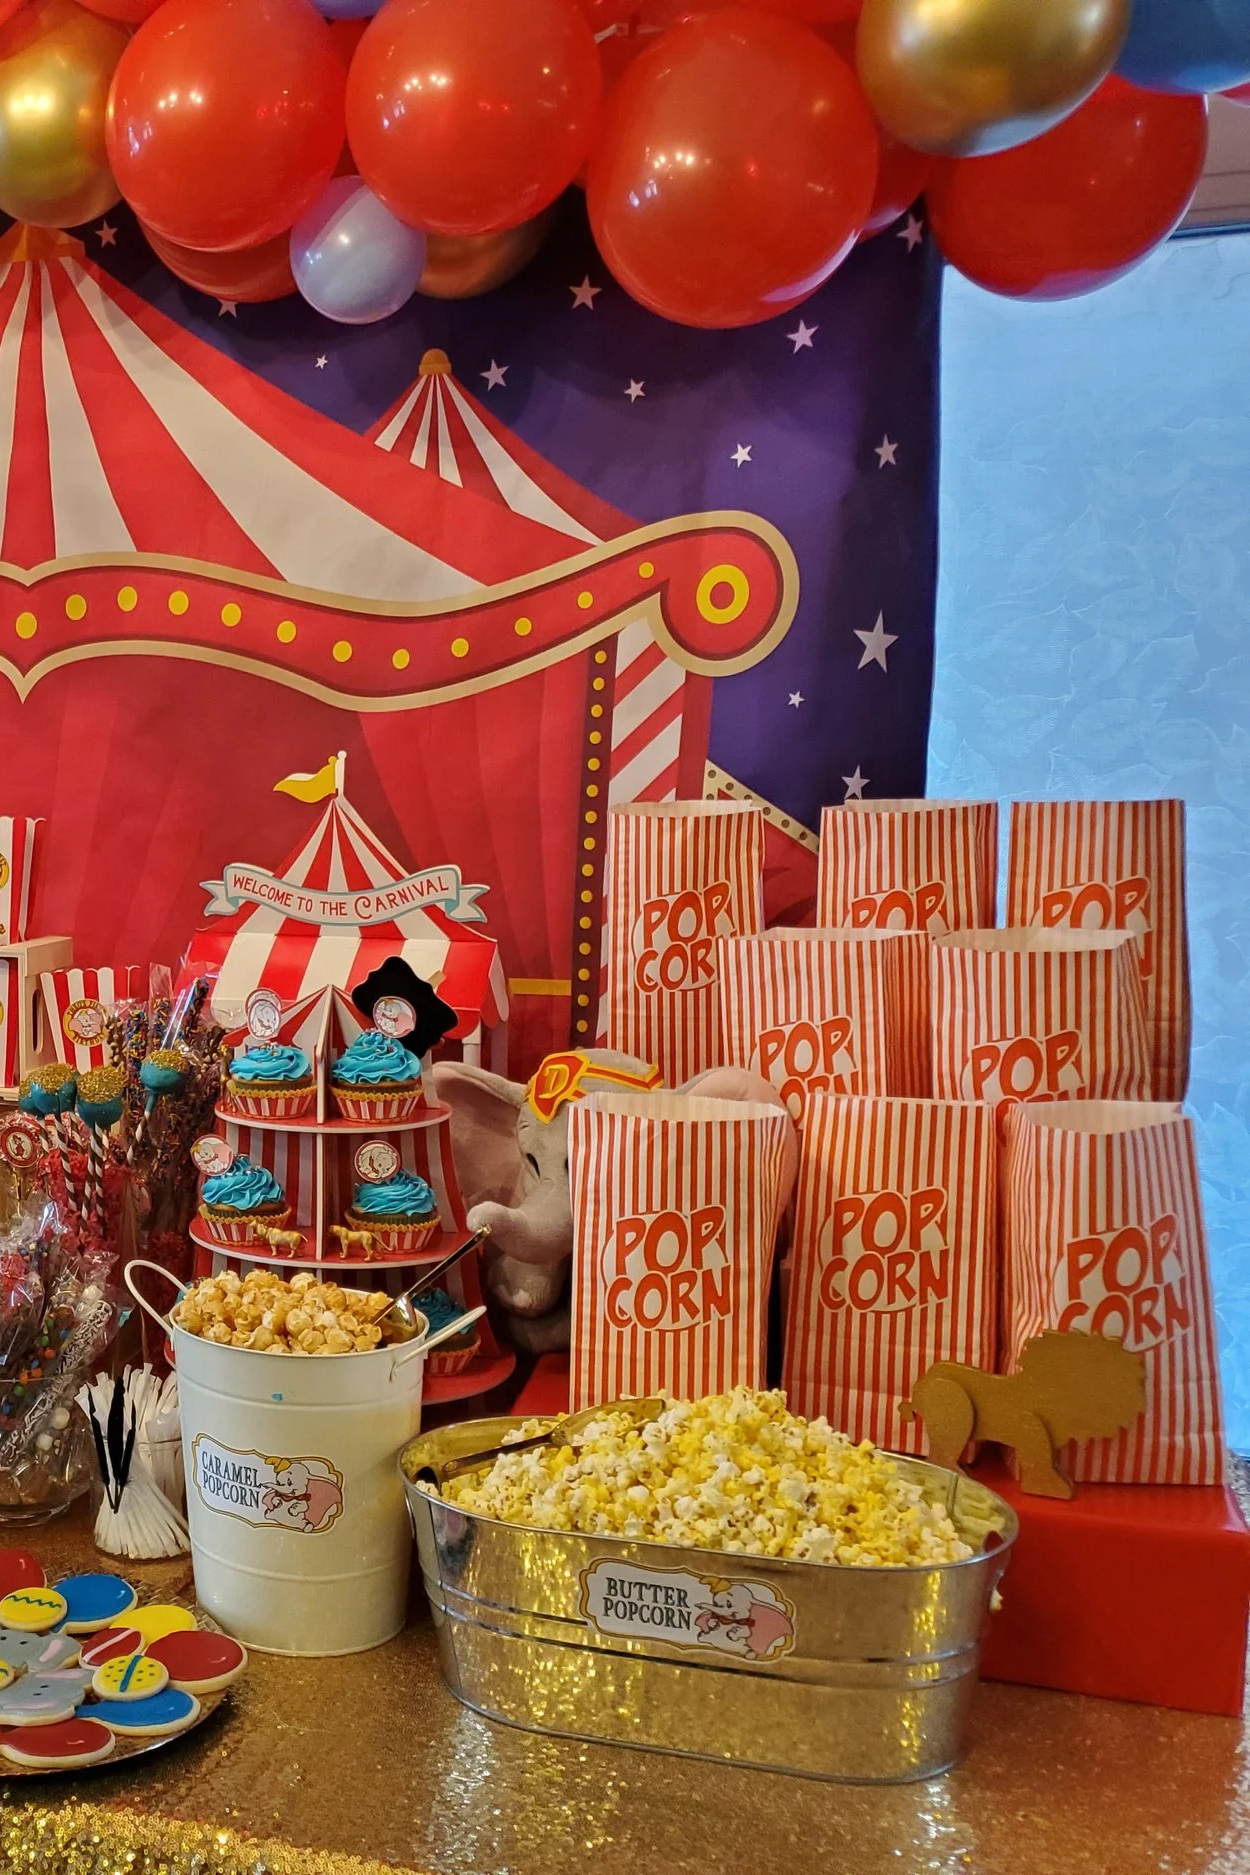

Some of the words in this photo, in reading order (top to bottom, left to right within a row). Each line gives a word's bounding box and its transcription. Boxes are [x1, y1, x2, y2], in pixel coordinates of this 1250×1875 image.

[233, 873, 294, 908] WELCOME
[297, 896, 314, 913] TO
[320, 901, 348, 916] THE
[354, 876, 450, 919] CARNIVAL
[643, 882, 730, 949] POP
[851, 882, 945, 931] POP
[1042, 877, 1150, 929] POP
[636, 931, 736, 993] COR
[759, 1017, 852, 1082] POP
[971, 1031, 1080, 1101] POP
[615, 1206, 725, 1277] POP
[832, 1188, 946, 1258] POP
[820, 1248, 950, 1311] CORN
[1066, 1214, 1178, 1301] POP
[606, 1264, 731, 1329] CORN
[1057, 1275, 1190, 1346] CORN
[201, 1450, 262, 1489] CARAMEL
[202, 1469, 261, 1510] POPCORN
[602, 1596, 693, 1631] POPCORN
[605, 1576, 691, 1609] BUTTER
